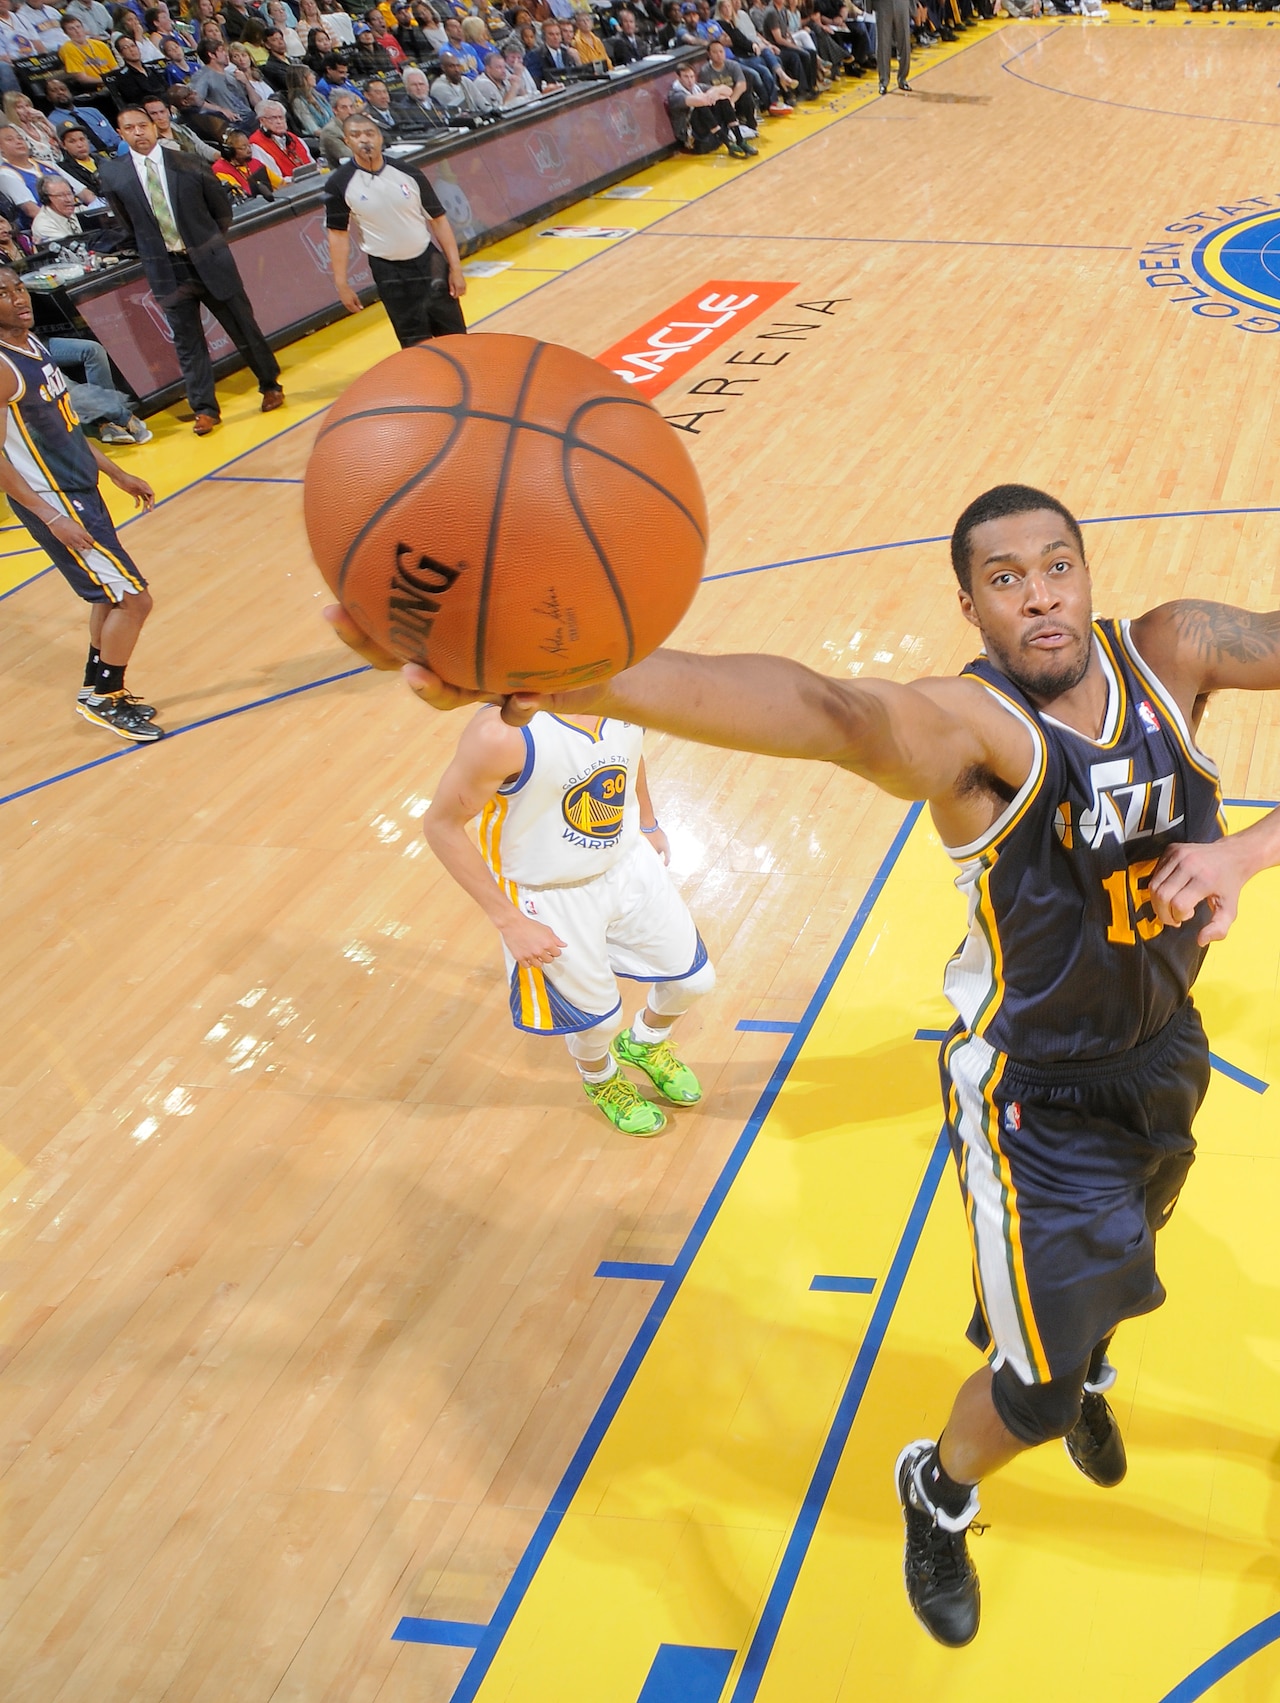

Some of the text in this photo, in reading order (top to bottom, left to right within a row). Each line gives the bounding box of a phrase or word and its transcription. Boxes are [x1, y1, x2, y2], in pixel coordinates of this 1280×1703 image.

[612, 292, 760, 384] RACLE
[663, 297, 852, 434] ARENA
[387, 542, 460, 660] DING
[562, 758, 606, 791] GOLDEN
[601, 773, 626, 800] 30
[1078, 758, 1185, 850] JAZZ
[1101, 858, 1165, 946] 15
